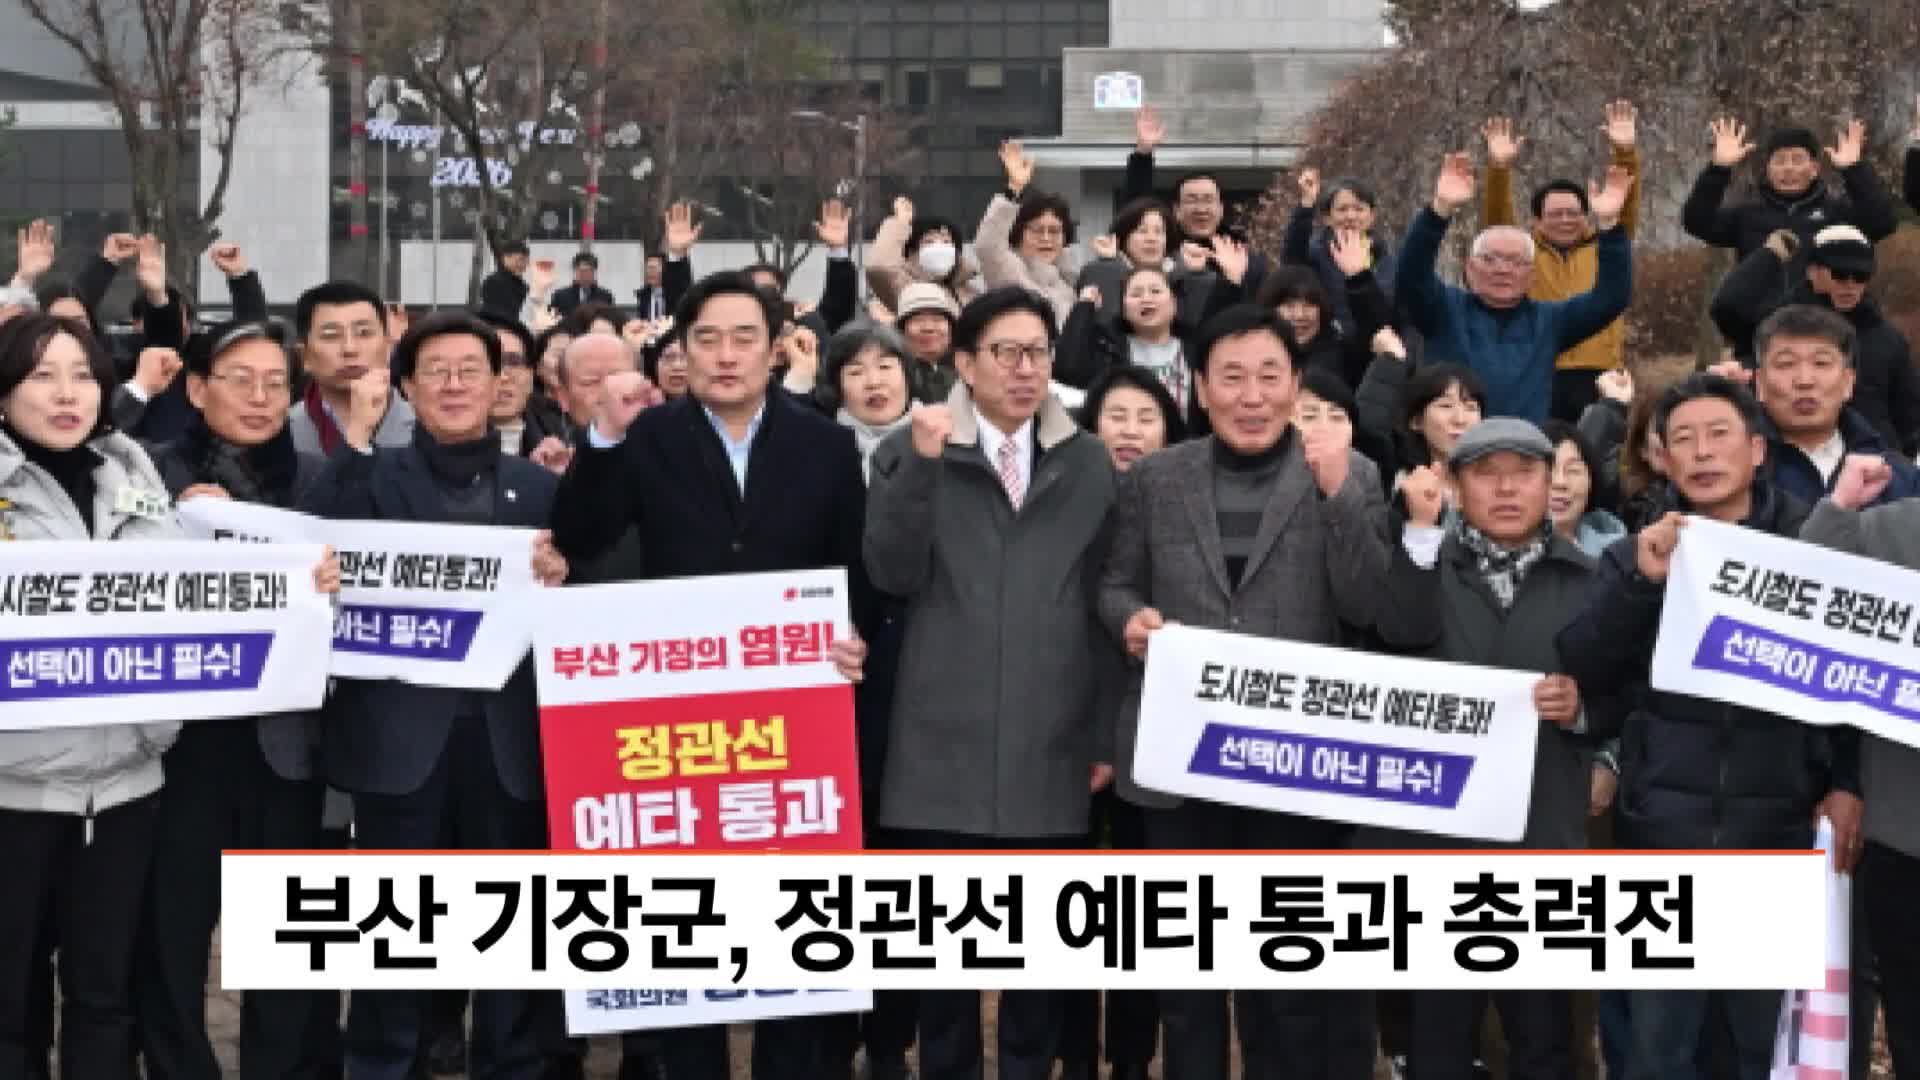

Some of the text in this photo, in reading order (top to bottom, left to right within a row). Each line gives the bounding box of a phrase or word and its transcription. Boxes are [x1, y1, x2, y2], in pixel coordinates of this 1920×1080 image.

[86, 569, 167, 615] 정관선
[175, 571, 288, 612] 예타통과!
[332, 550, 501, 592] 관선 예타통과!
[1710, 557, 1823, 620] 도시철도
[1824, 586, 1913, 645] 정관선
[389, 613, 453, 649] 필수!
[552, 620, 834, 679] 부산 기장의 염원!
[8, 643, 242, 688] 선택이 아닌 필수!
[1723, 629, 1817, 684] 선택이
[1823, 659, 1888, 699] 아닌
[1195, 662, 1495, 736] 도시철도 정관선 예타통과!
[615, 715, 788, 781] 정관선
[1218, 734, 1443, 795] 선택이 아닌 필수!
[574, 776, 845, 850] 예타 통과
